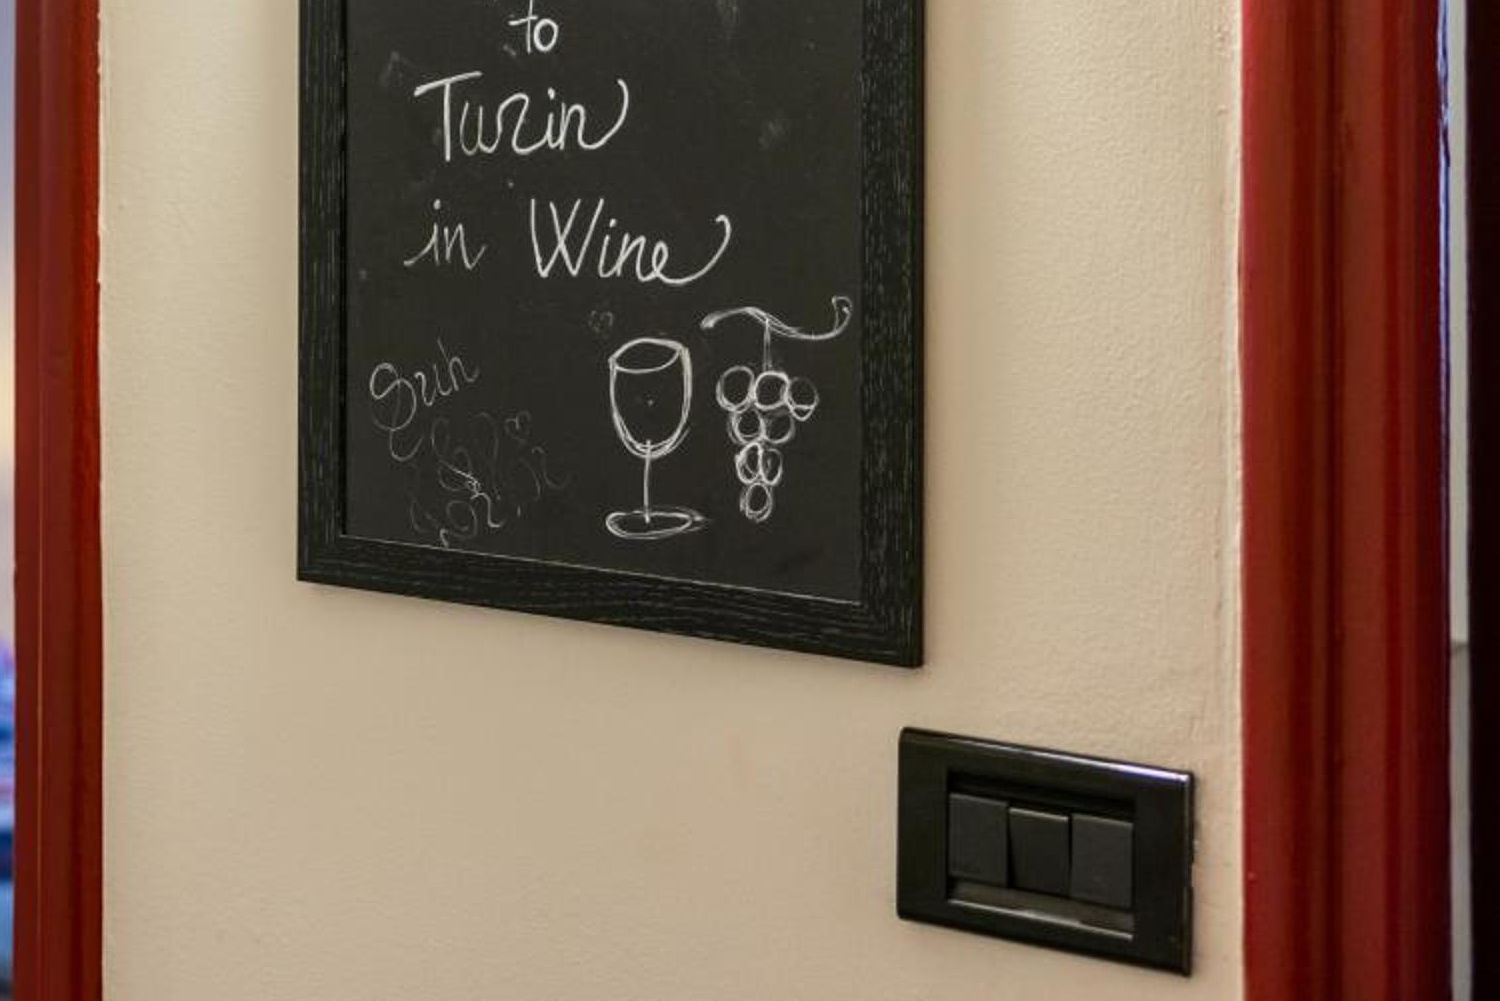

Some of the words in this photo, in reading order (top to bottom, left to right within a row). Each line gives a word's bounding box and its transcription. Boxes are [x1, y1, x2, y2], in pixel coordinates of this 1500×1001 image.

[413, 70, 630, 162] Turin
[403, 199, 488, 271] in
[531, 198, 732, 286] Wine
